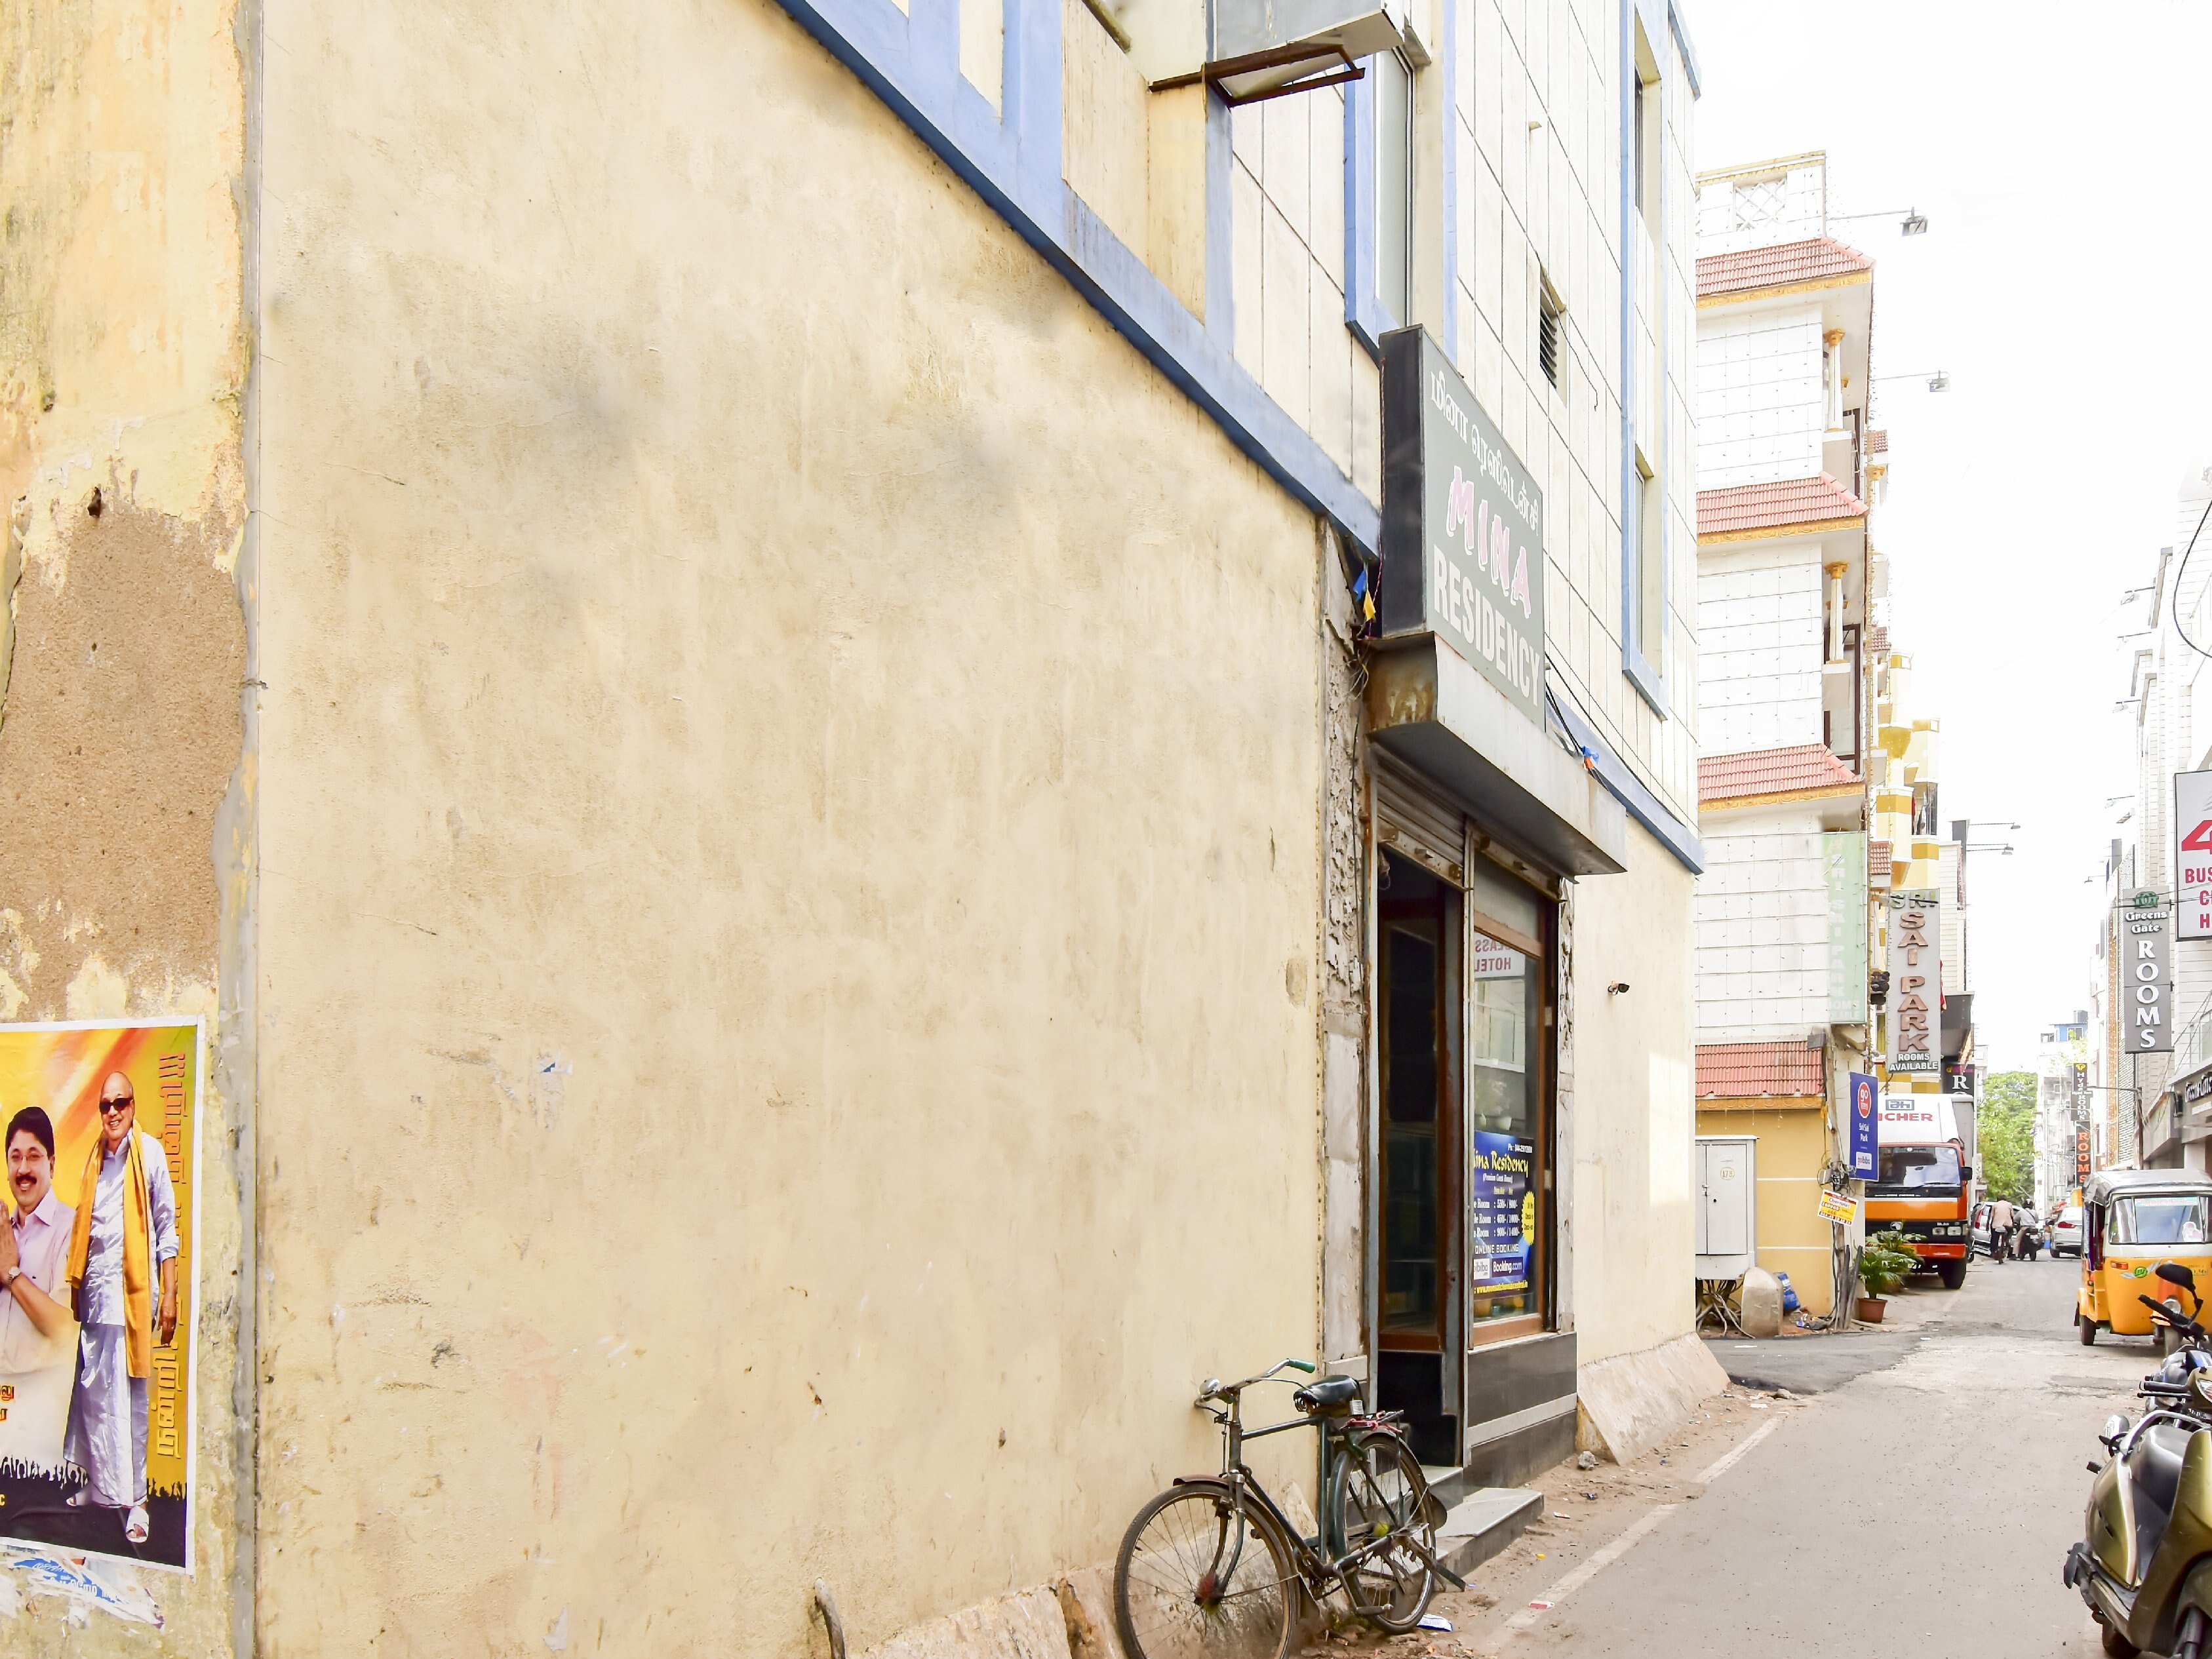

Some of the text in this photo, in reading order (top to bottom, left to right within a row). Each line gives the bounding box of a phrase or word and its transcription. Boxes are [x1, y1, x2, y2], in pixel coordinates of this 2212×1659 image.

[1447, 465, 1531, 619] MINA
[1433, 544, 1540, 706] RESIDENCY
[2125, 911, 2167, 922] Greens
[2131, 924, 2161, 933] Gate
[1897, 911, 1929, 1051] SAI PARK
[2136, 940, 2161, 1048] ROOMS
[1897, 1053, 1930, 1062] ROOMS
[1889, 1061, 1939, 1071] AVAILABLE
[1860, 1089, 1868, 1102] go
[1878, 1113, 1933, 1122] ICHER
[2078, 1132, 2090, 1183] ROOMS
[1491, 1150, 1529, 1178] Residency
[1477, 1198, 1490, 1209] Room
[1479, 1213, 1491, 1224] Room
[1477, 1227, 1489, 1238] Room
[1474, 1244, 1519, 1254] ONLINE BOOKING
[1493, 1260, 1522, 1274] Booking.com
